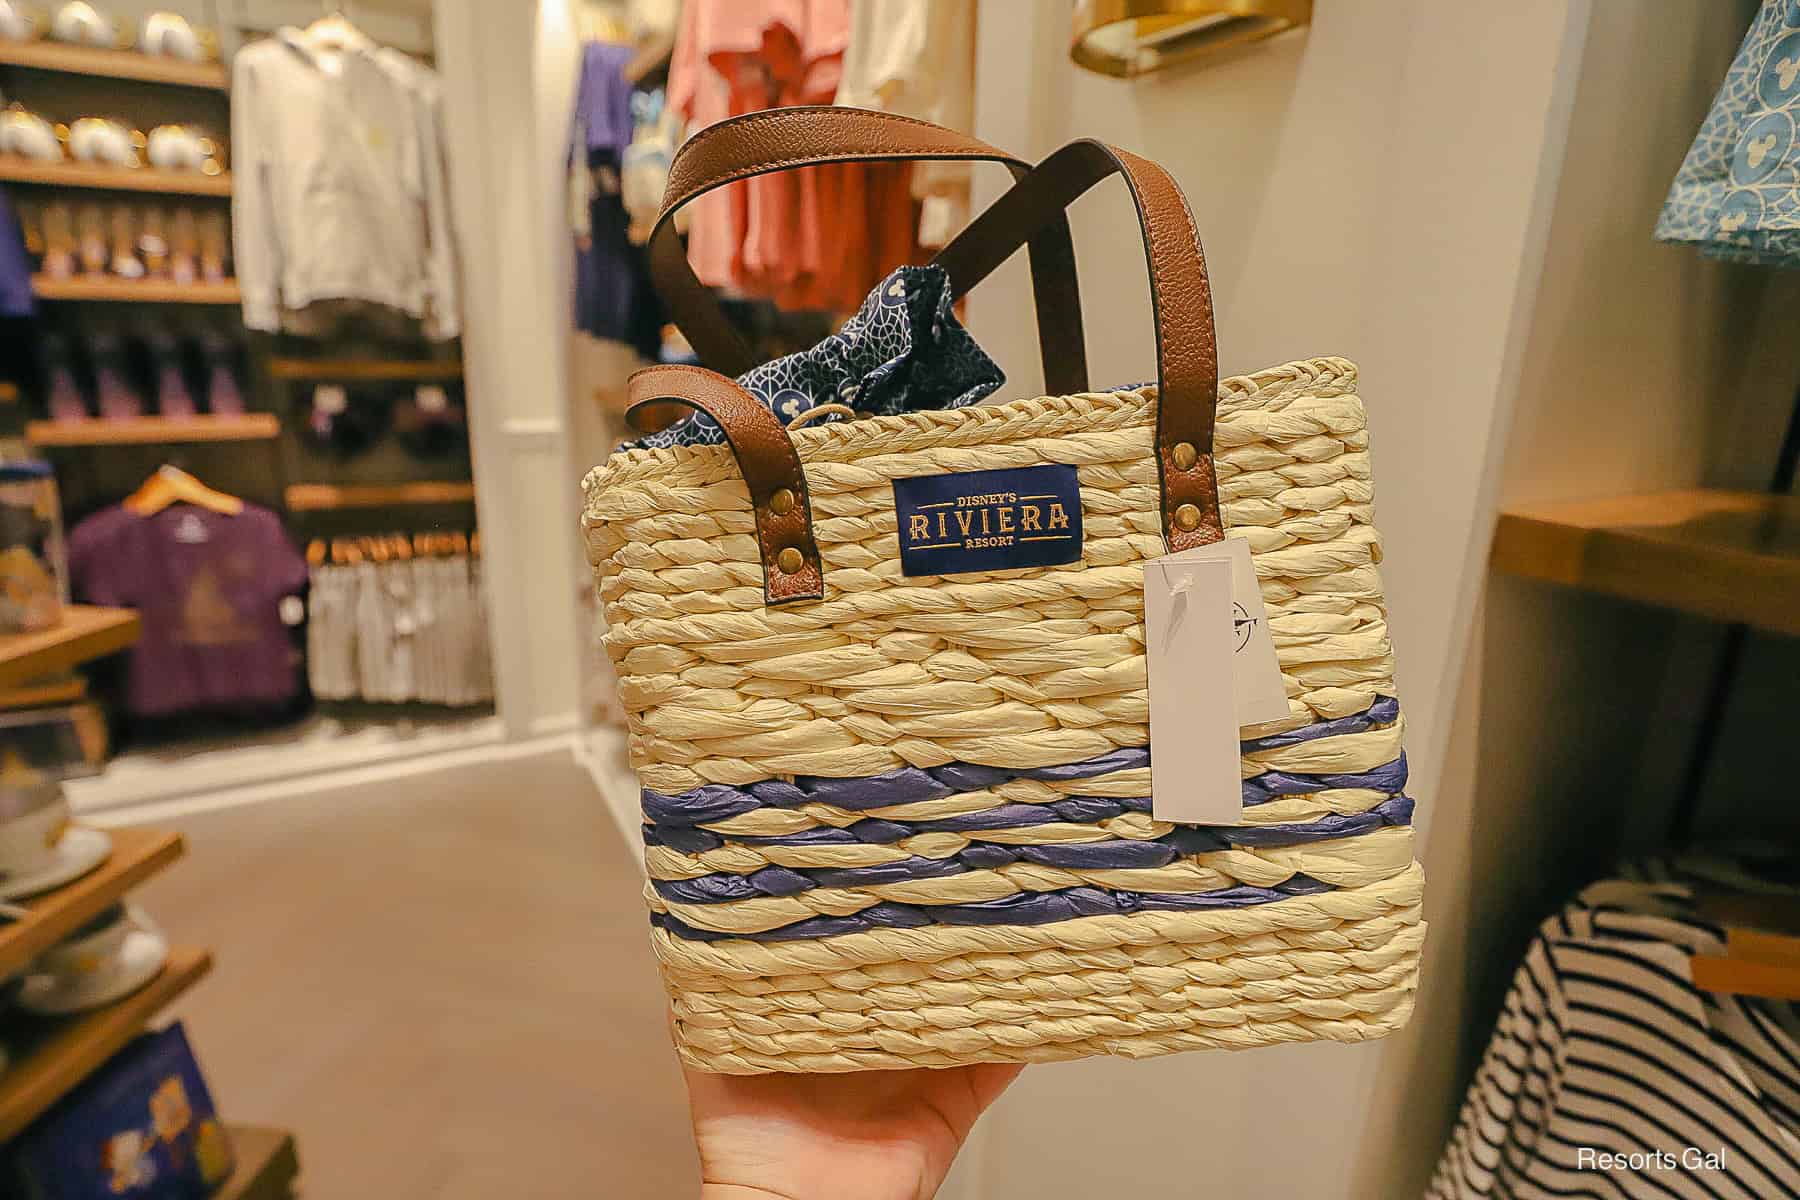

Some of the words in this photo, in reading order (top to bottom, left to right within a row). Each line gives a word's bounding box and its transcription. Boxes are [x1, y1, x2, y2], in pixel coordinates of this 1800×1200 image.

[956, 492, 1017, 507] DISNEY'S
[908, 503, 1070, 541] RIVIERA
[965, 536, 1015, 549] RESORT
